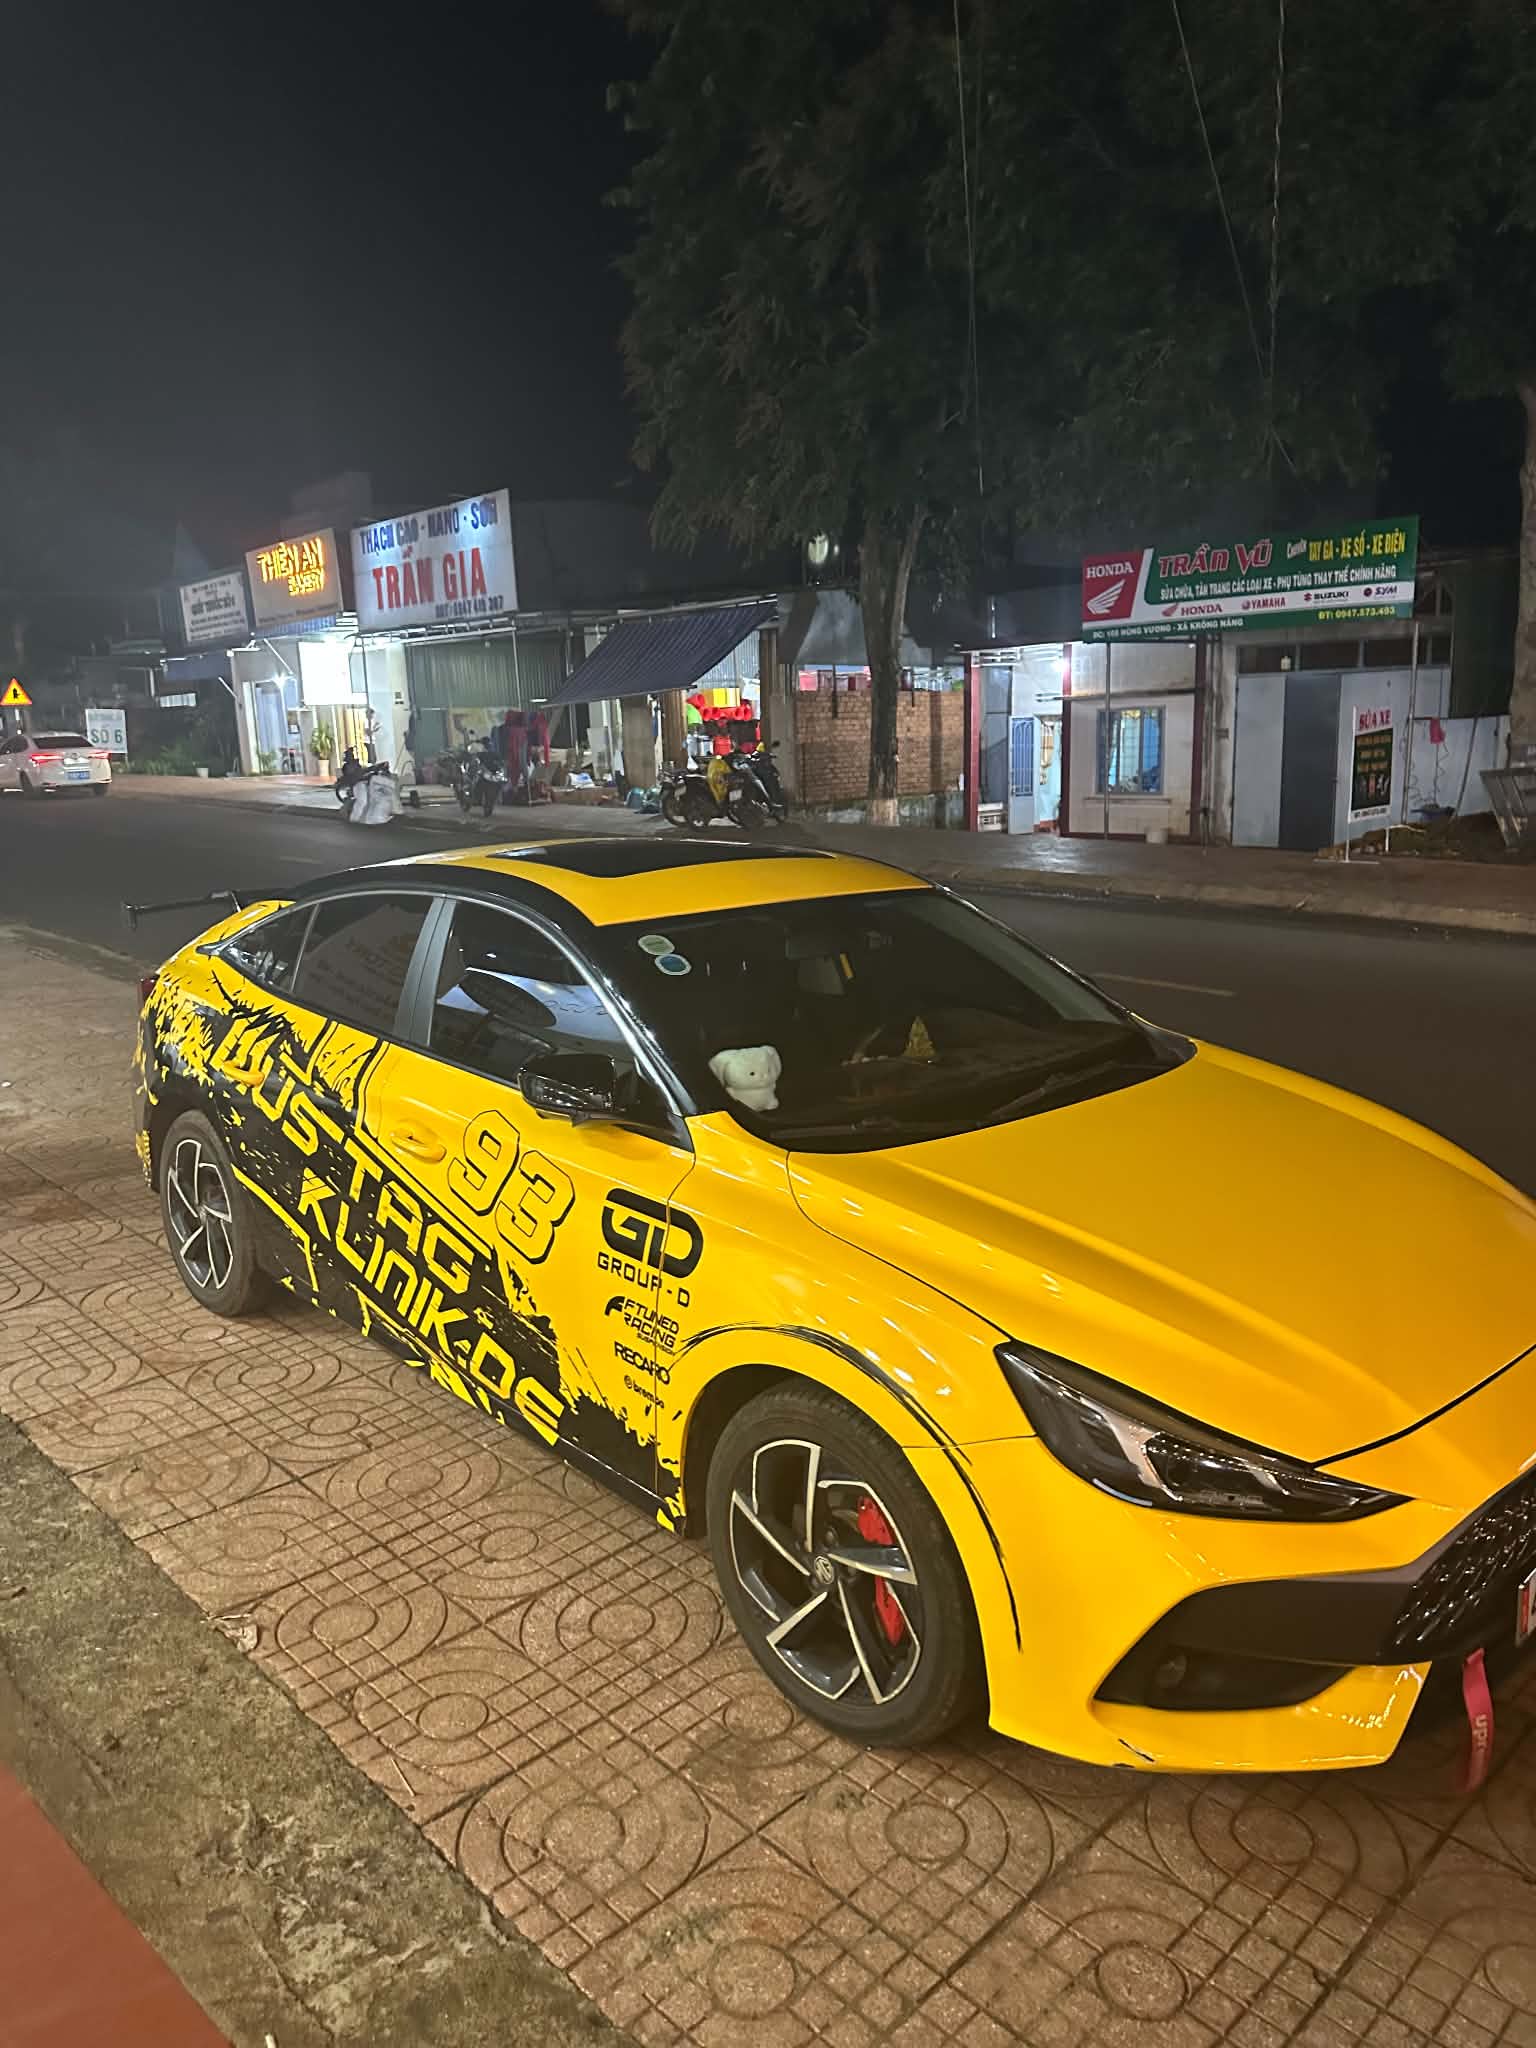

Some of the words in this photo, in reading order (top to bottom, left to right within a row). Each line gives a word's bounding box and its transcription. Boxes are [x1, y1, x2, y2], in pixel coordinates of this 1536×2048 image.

[428, 508, 460, 538] NANO
[302, 536, 324, 571] AN
[1322, 539, 1334, 560] GA
[1340, 537, 1352, 559] XE
[1353, 528, 1365, 557] SỐ
[1371, 533, 1384, 555] XE
[443, 547, 487, 600] GIA
[1086, 561, 1135, 579] HONDA
[1231, 578, 1246, 593] CÁC
[1263, 577, 1273, 590] XE
[1313, 570, 1333, 585] THAY
[1333, 564, 1349, 583] THẾ
[1180, 603, 1223, 617] HONDA
[1251, 597, 1286, 609] YAMAHA
[1313, 591, 1349, 600] SUZUKI
[1374, 585, 1398, 596] SYM
[1380, 709, 1391, 726] XE
[114, 729, 123, 743] 6
[447, 1109, 576, 1265] 93
[624, 1311, 676, 1349] RACING
[614, 1340, 671, 1385] RECARO
